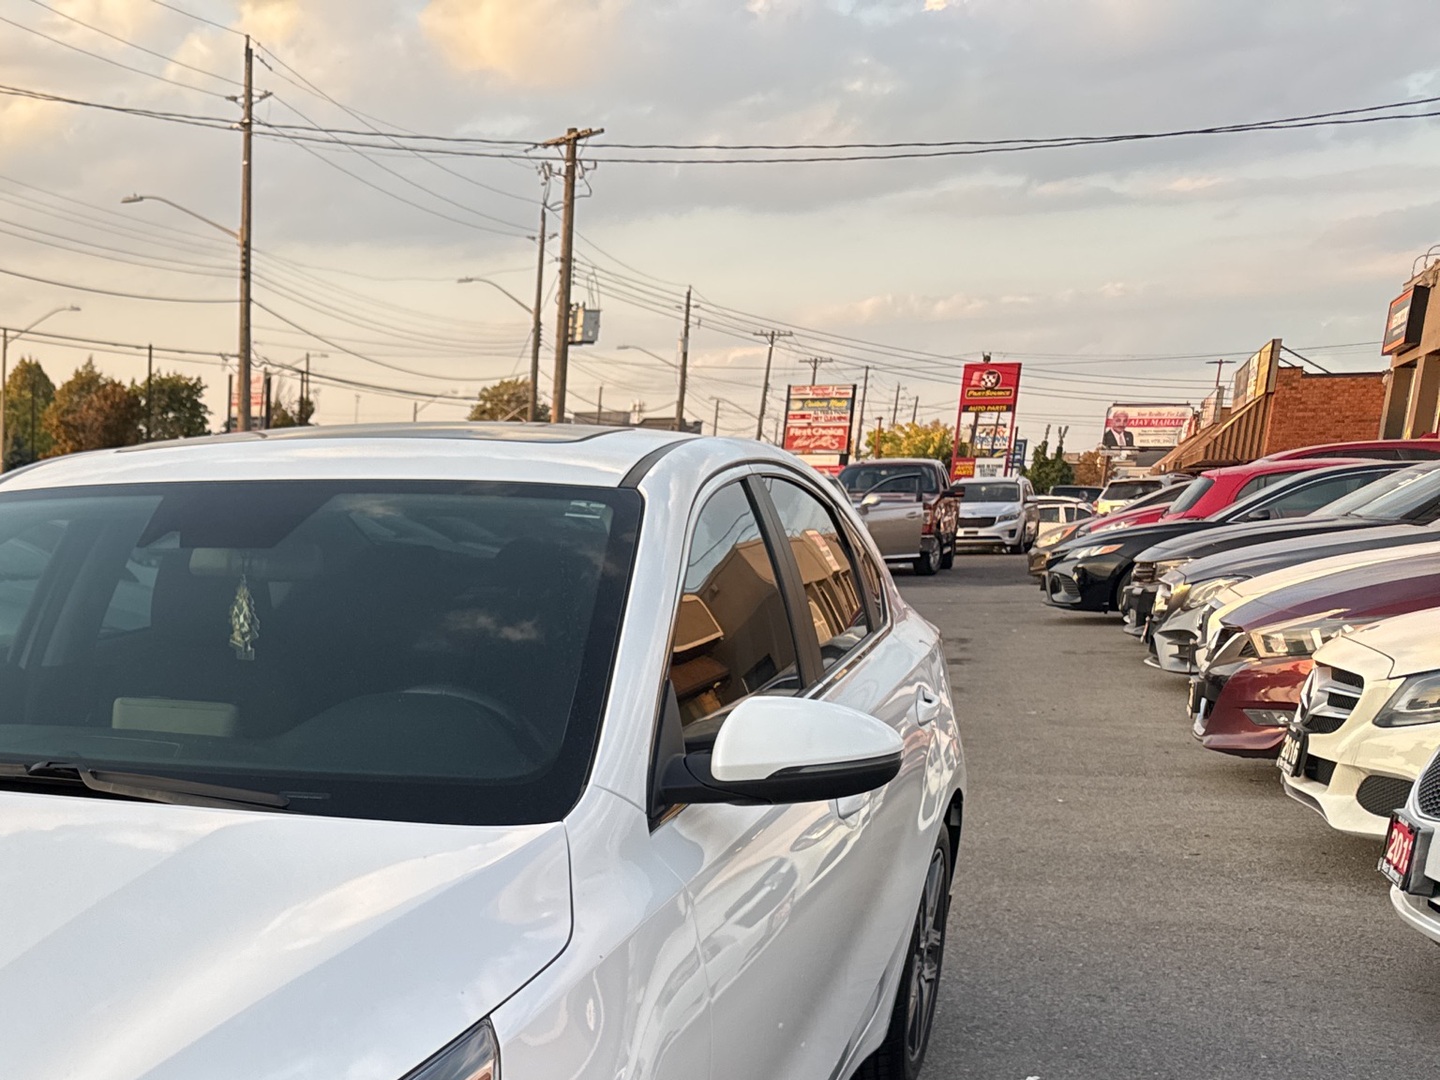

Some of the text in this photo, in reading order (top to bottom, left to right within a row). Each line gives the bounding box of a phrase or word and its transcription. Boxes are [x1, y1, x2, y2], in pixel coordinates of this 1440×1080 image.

[1130, 418, 1147, 426] AJAY
[789, 427, 844, 436] First Choice
